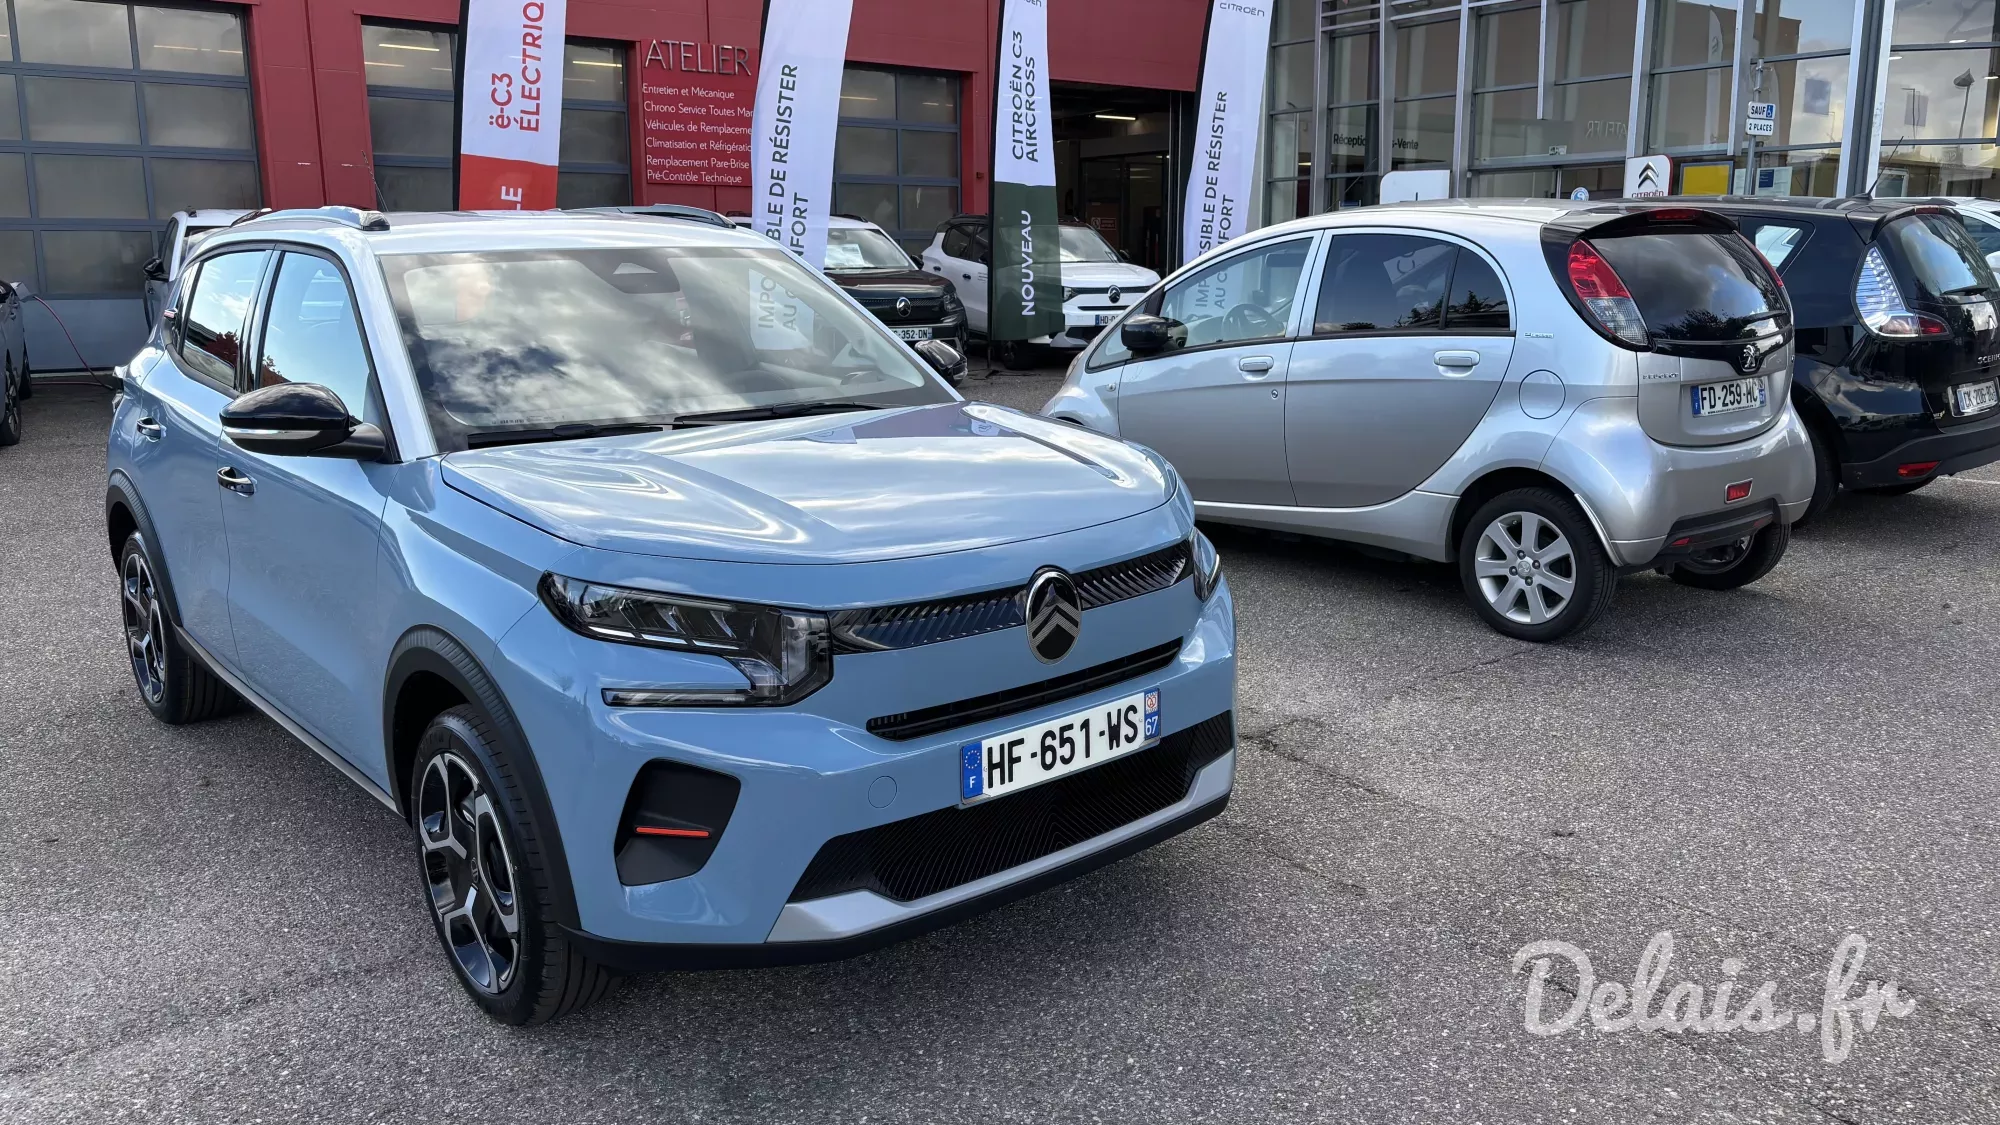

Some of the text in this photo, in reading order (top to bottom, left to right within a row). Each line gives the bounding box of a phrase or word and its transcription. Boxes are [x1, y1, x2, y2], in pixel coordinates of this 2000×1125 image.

[1219, 2, 1265, 17] CITROËN
[513, 1, 545, 132] ÉLECTRIQ
[643, 39, 752, 76] ATELIER
[642, 83, 679, 95] Entretien
[691, 87, 735, 101] Mécanique
[1009, 30, 1024, 160] CITROËN C3
[643, 101, 676, 113] Chrono
[678, 103, 707, 115] Service
[709, 105, 735, 117] Toutes
[769, 64, 798, 164] RÉSISTER
[1025, 56, 1039, 163] AIRCROSS
[1750, 105, 1766, 115] SAUF
[645, 119, 685, 131] Véhicules
[687, 121, 698, 132] de
[1205, 91, 1228, 172] RÉSISTER
[1748, 122, 1773, 132] 2 PLACES
[645, 137, 698, 149] Climatisation
[699, 141, 708, 150] et
[646, 154, 750, 169] Remplacement Pare-Brise
[646, 169, 743, 185] Pré-Contrôle Technique
[769, 168, 787, 198] DE
[1204, 175, 1219, 199] DE
[1217, 194, 1234, 245] FORT
[1021, 210, 1036, 316] NOUVEAU
[1214, 287, 1226, 310] AU
[1700, 377, 1758, 411] FD-259-HC
[969, 704, 1159, 789] F HF-651-WS 67
